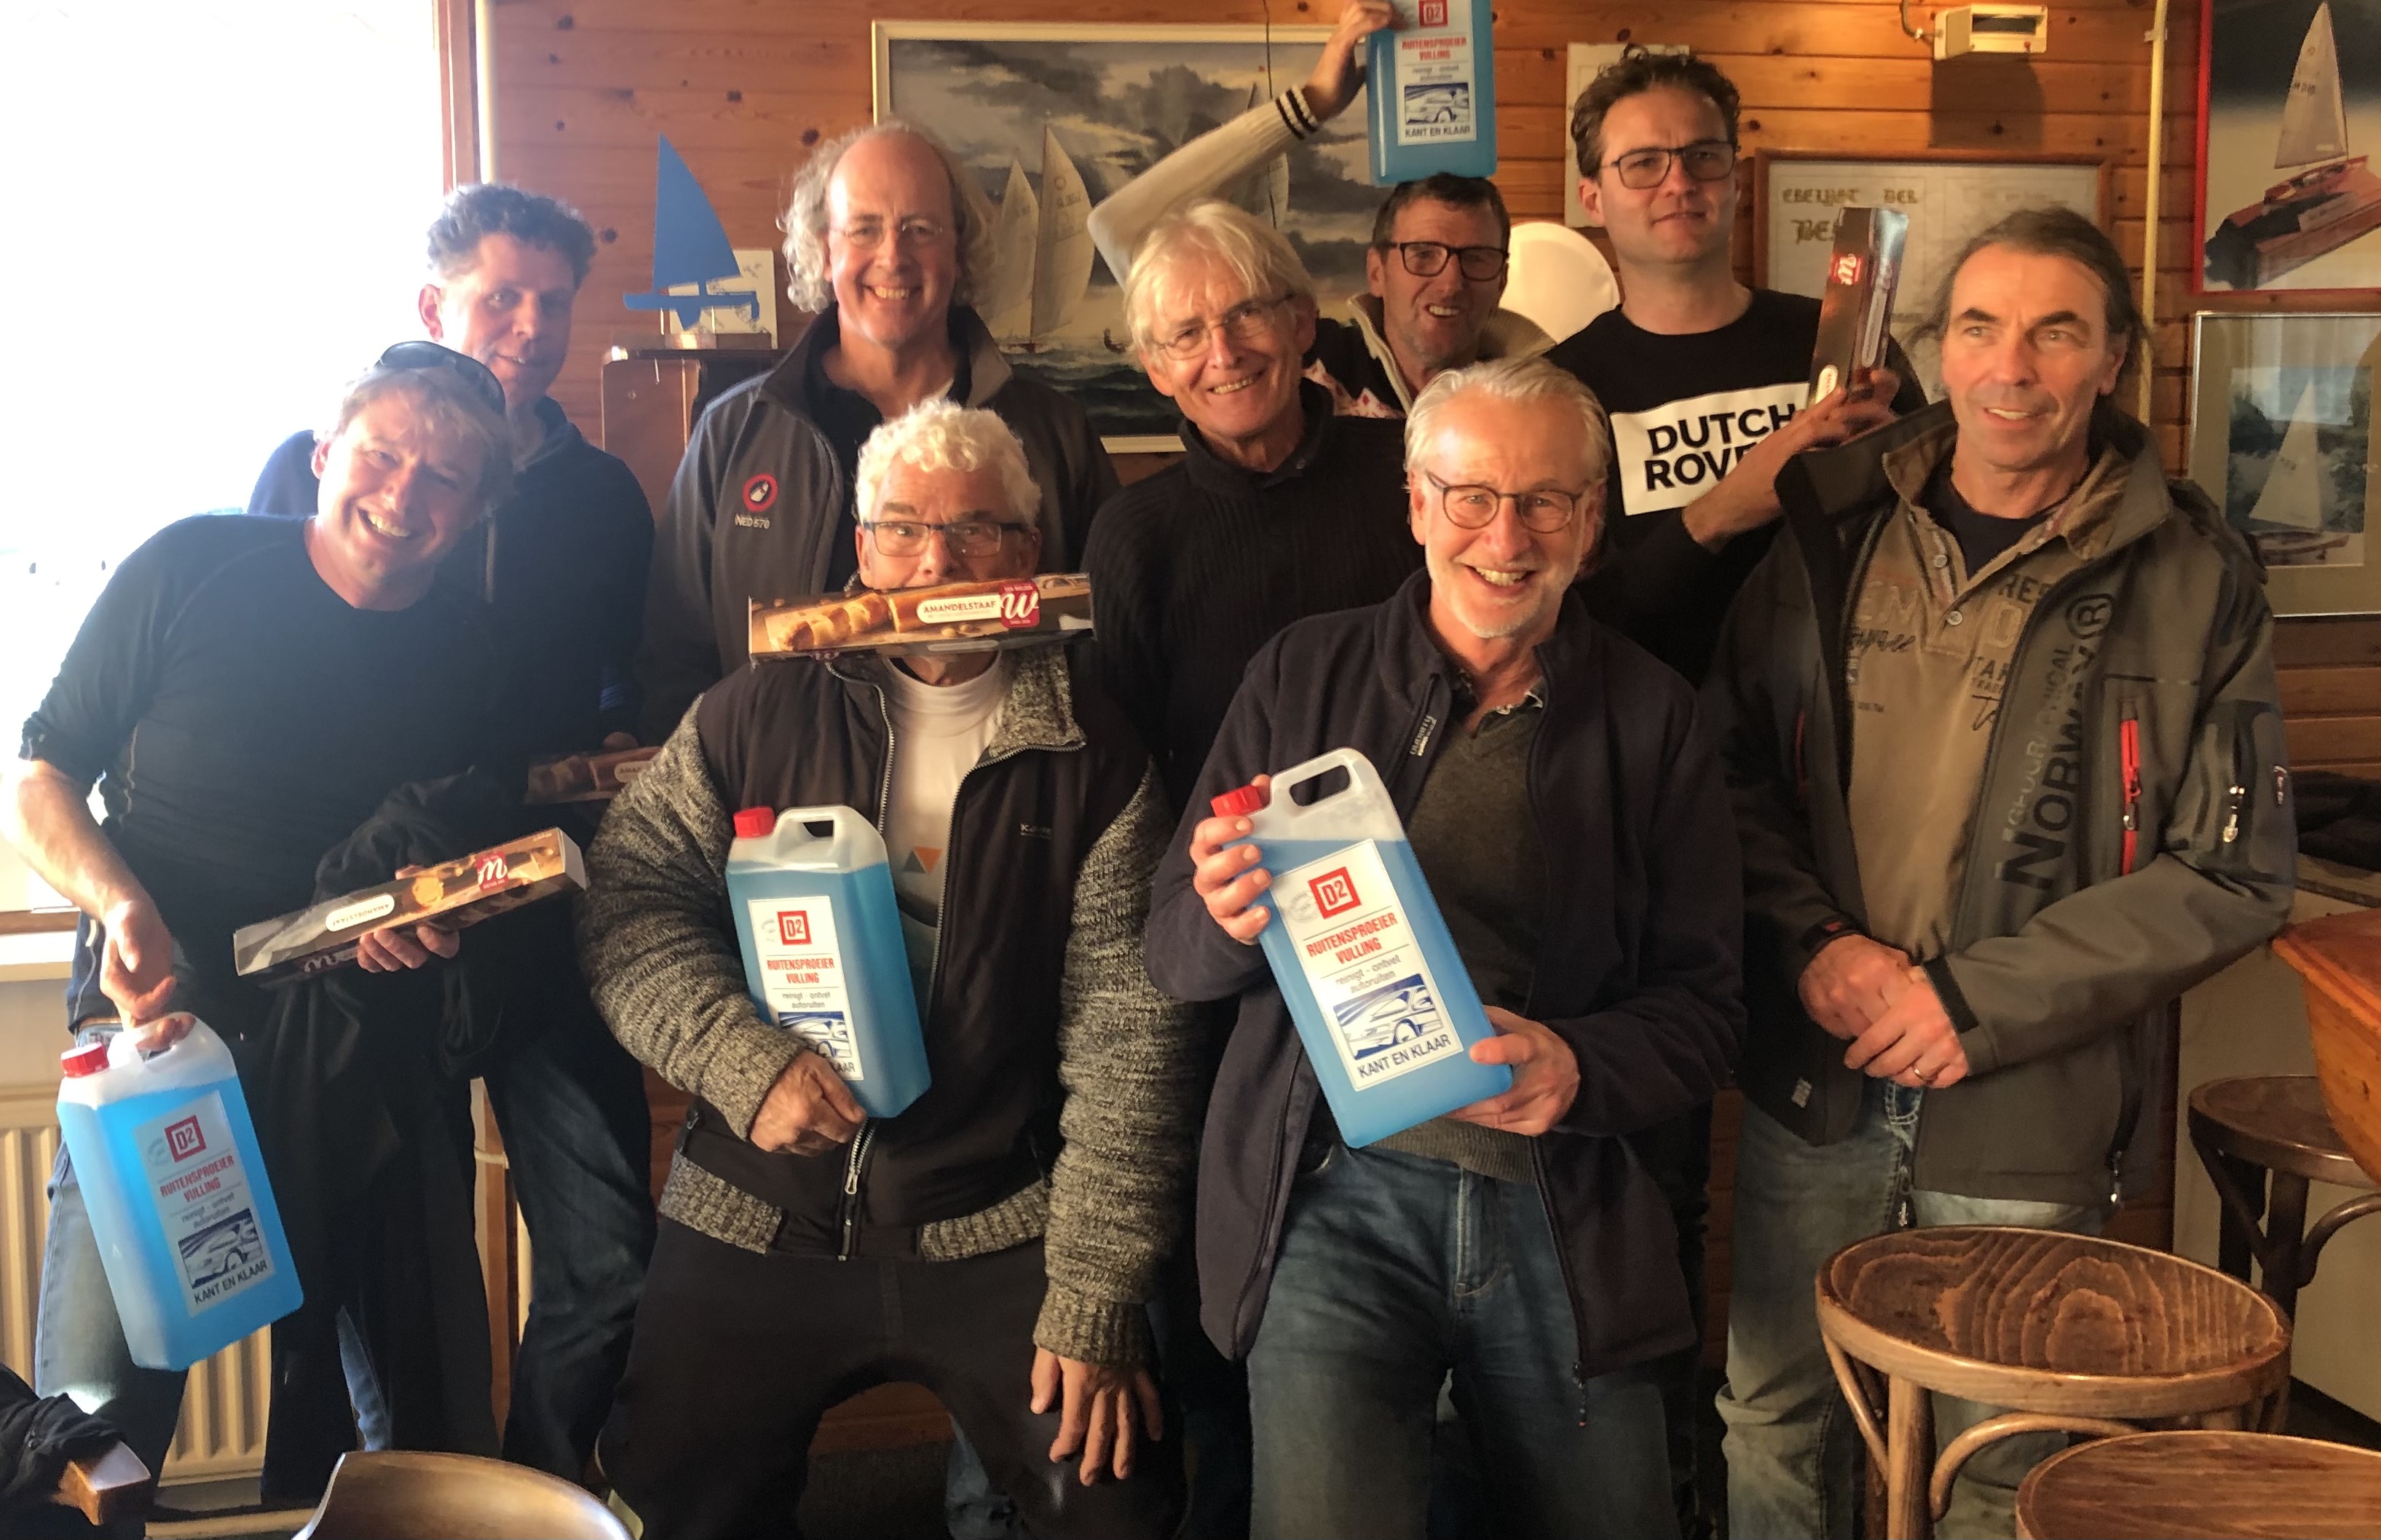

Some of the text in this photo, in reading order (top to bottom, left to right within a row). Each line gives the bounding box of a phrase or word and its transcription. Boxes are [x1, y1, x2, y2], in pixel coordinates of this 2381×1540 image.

[1405, 127, 1427, 138] KANT
[1443, 126, 1470, 136] KLAAR
[1647, 403, 1796, 456] DUTCH
[734, 513, 770, 529] NED 570
[923, 601, 997, 614] AMANDELSTAAF
[1322, 880, 1348, 907] D2
[786, 919, 805, 938] D2
[1306, 912, 1398, 957] RUITENSPROEIER
[1335, 936, 1383, 964] VULLING
[766, 957, 835, 971] RUITENSPROEIER
[786, 973, 820, 984] VULLING
[1357, 1034, 1452, 1078] KANT EN KLAAR
[175, 1127, 196, 1151] D2
[159, 1155, 235, 1198] RUITENSPROEIER
[183, 1177, 221, 1202] VULLING
[194, 1260, 269, 1306] KANT EN KLAAR
